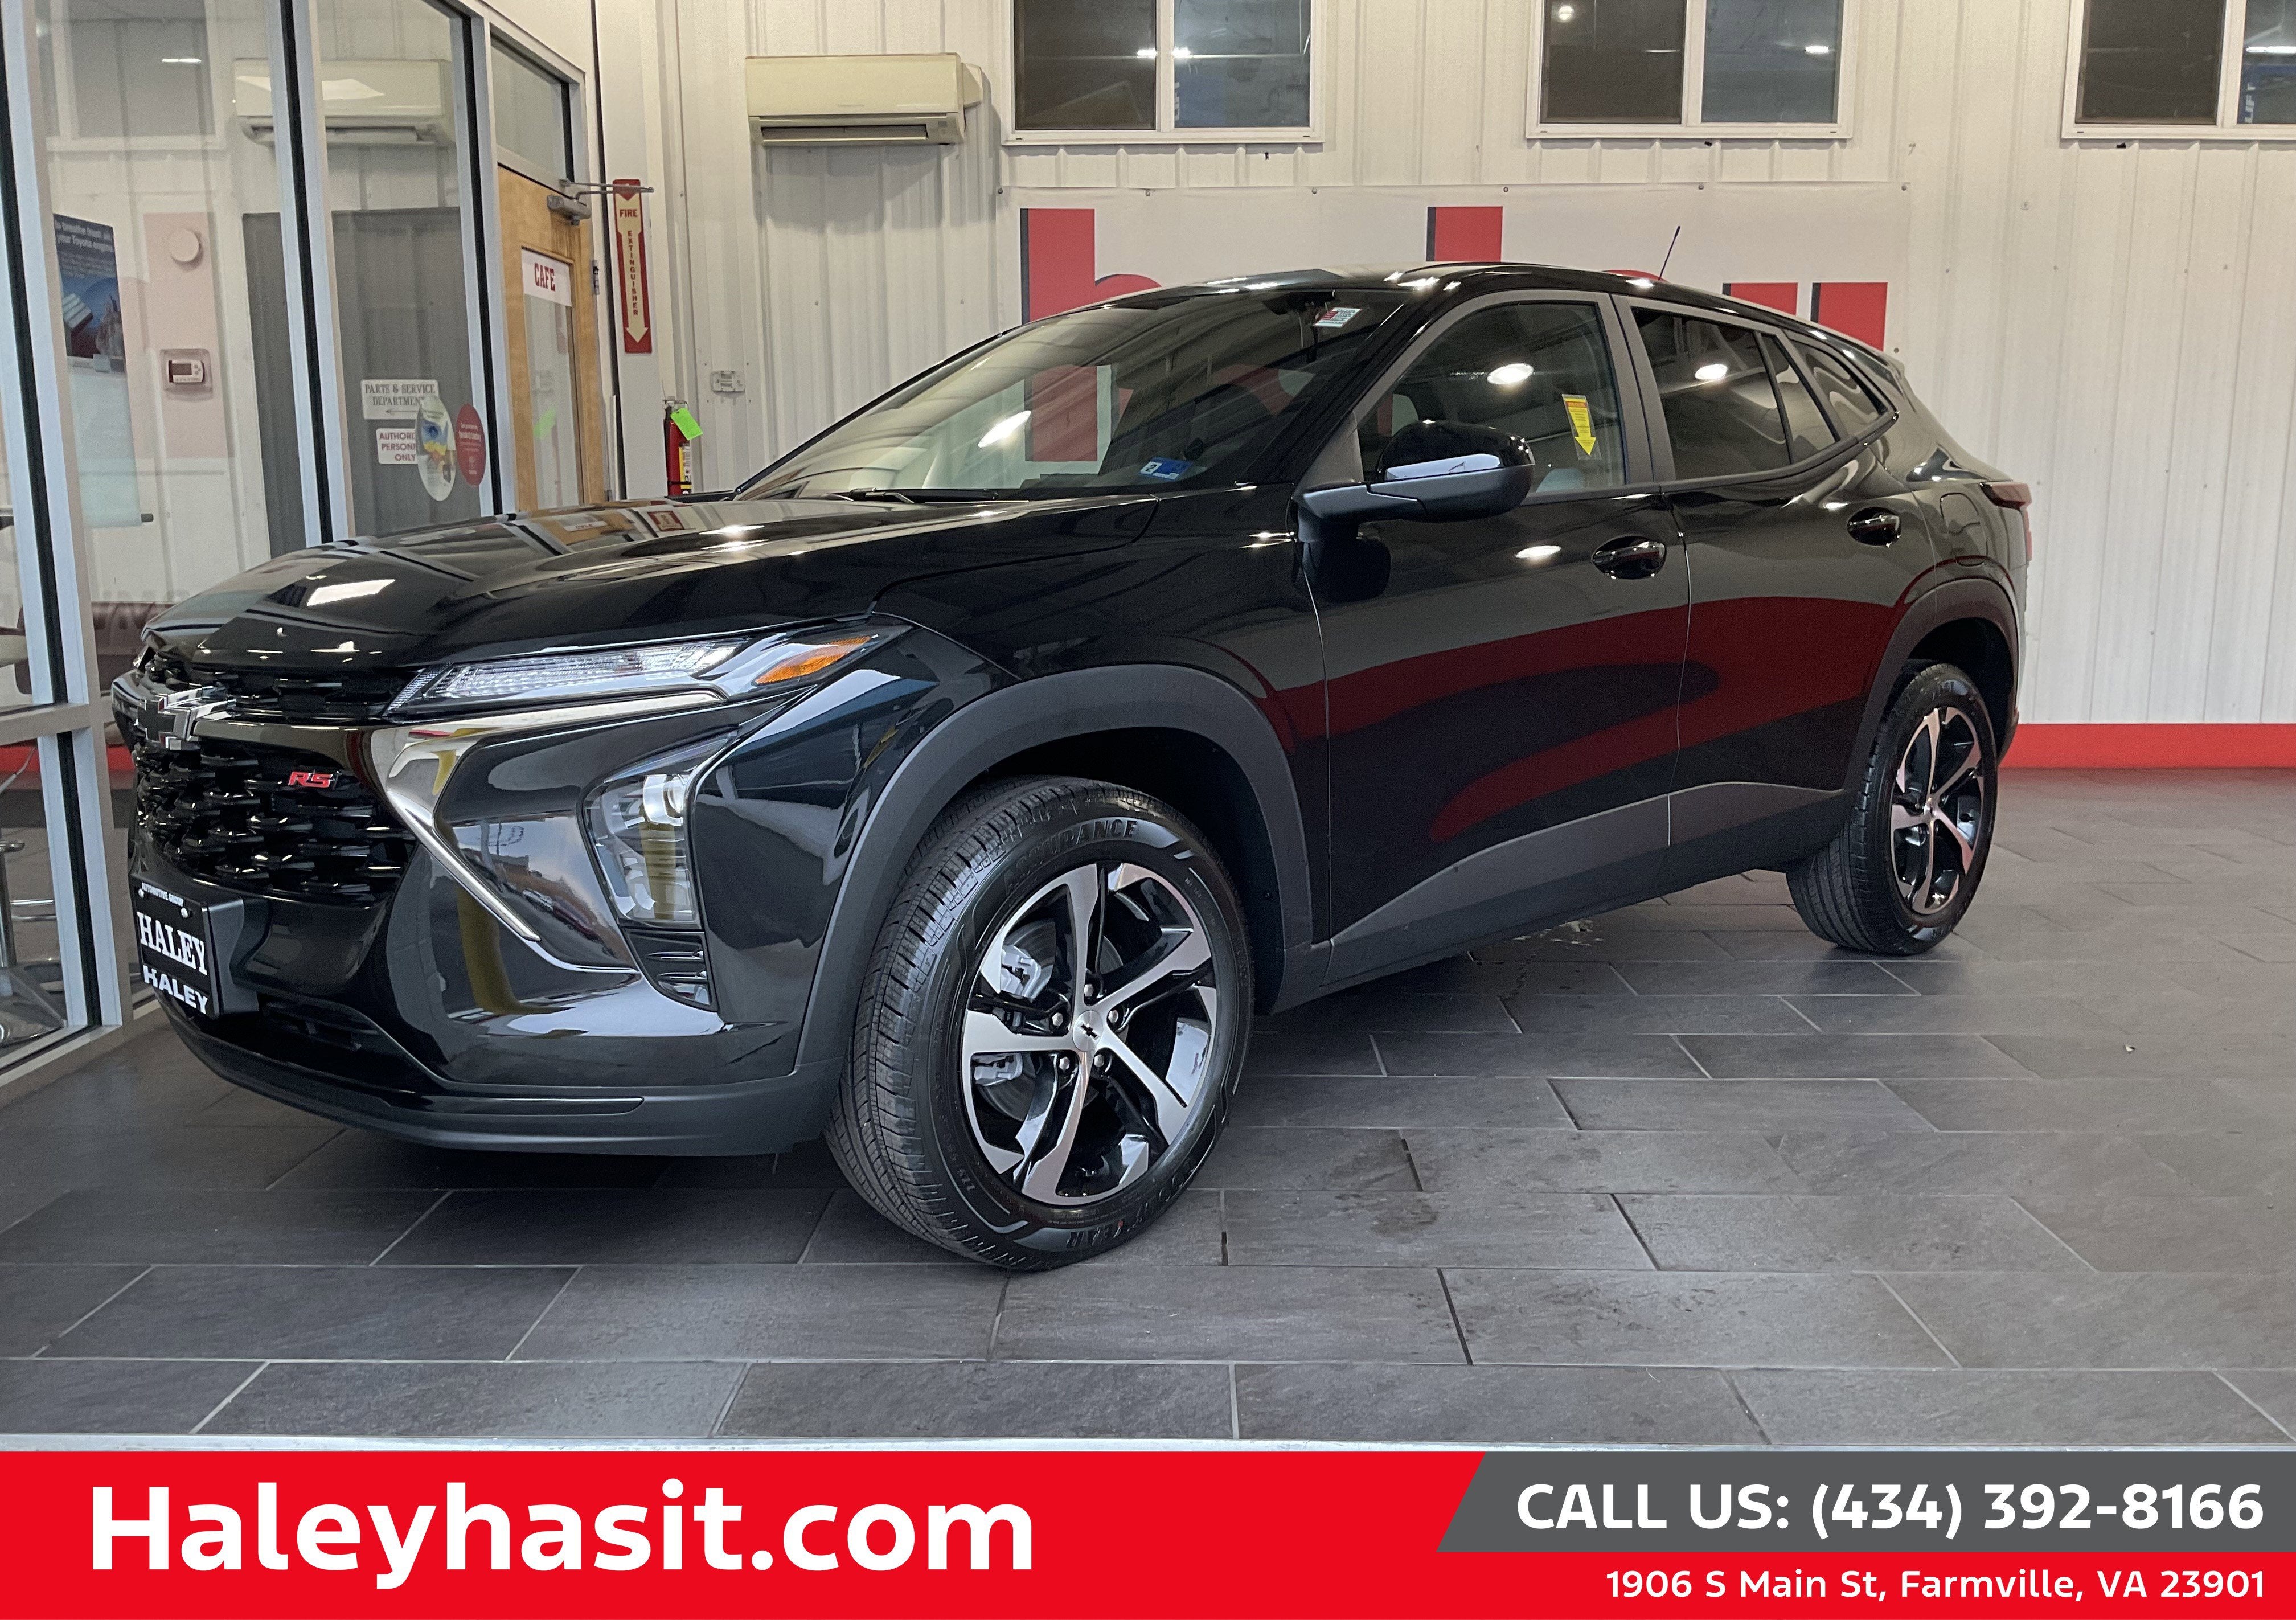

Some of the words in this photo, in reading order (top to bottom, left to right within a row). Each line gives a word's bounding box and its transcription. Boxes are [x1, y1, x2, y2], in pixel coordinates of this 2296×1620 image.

[619, 208, 638, 218] FIRE
[534, 262, 556, 292] CAFE
[627, 230, 639, 315] EXTINGUISHER
[365, 384, 391, 394] PARTS
[392, 384, 399, 393] &
[401, 384, 436, 394] SERVICE
[288, 771, 333, 789] RS
[136, 911, 208, 977] HALEY
[142, 964, 208, 1015] HALEY
